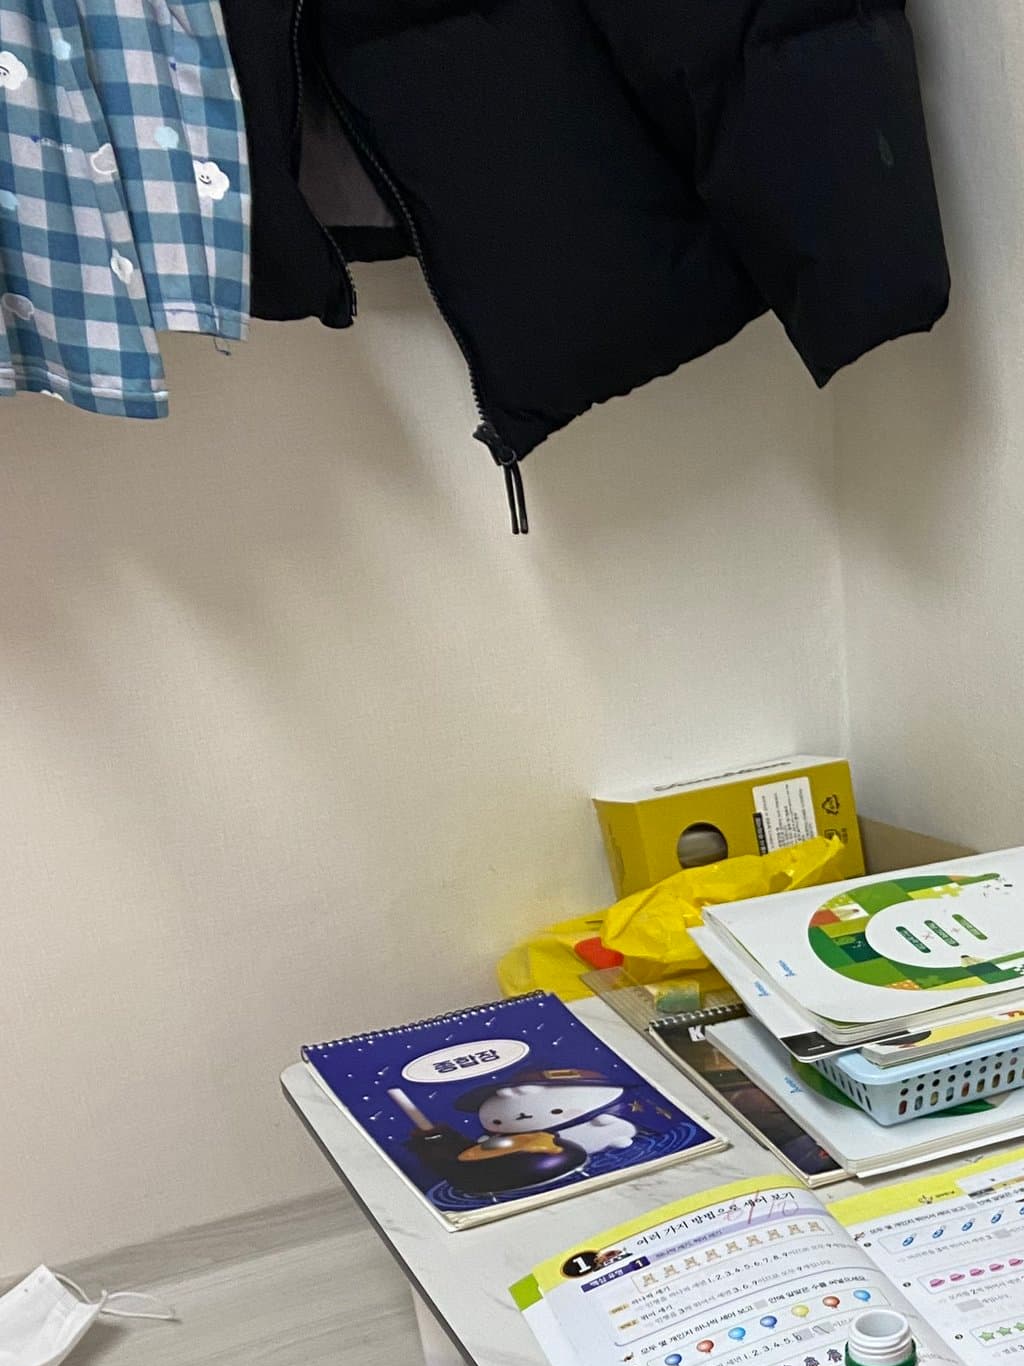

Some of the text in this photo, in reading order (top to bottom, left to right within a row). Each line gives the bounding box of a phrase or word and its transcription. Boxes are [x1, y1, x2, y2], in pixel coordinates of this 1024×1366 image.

[433, 1049, 500, 1073] 종합장
[664, 1220, 689, 1235] 가지
[771, 1191, 795, 1202] 보기
[573, 1257, 591, 1274] 1
[634, 1259, 643, 1267] 1
